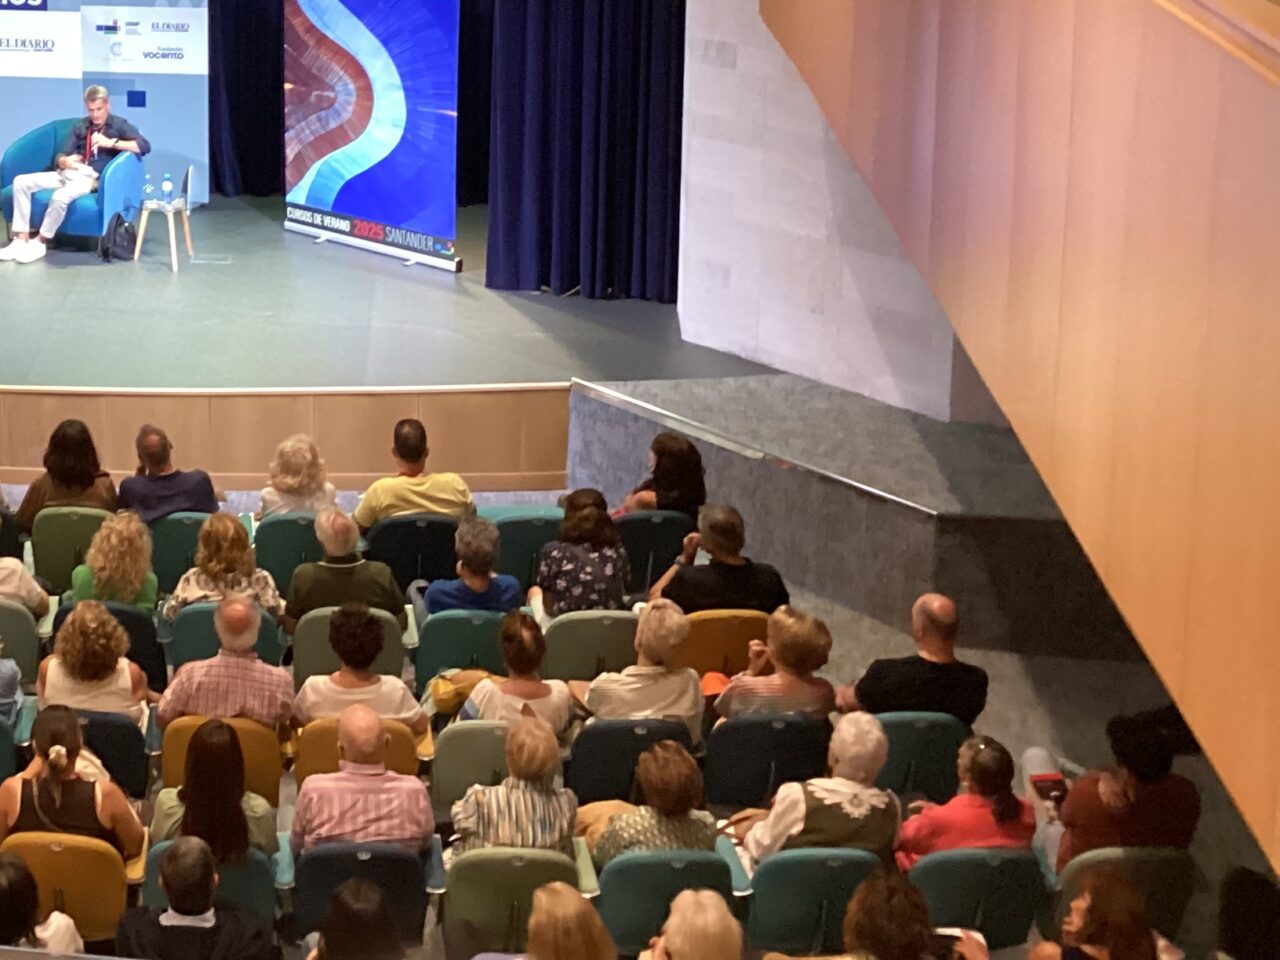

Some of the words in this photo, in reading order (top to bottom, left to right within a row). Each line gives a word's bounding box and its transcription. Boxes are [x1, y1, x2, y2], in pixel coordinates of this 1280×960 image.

[0, 38, 14, 48] EL
[14, 38, 55, 49] DIARIO
[286, 206, 313, 223] CURSOS
[313, 212, 322, 226] DE
[322, 214, 351, 233] VERANO
[352, 219, 384, 239] 2025
[385, 226, 434, 252] SANTANDER
